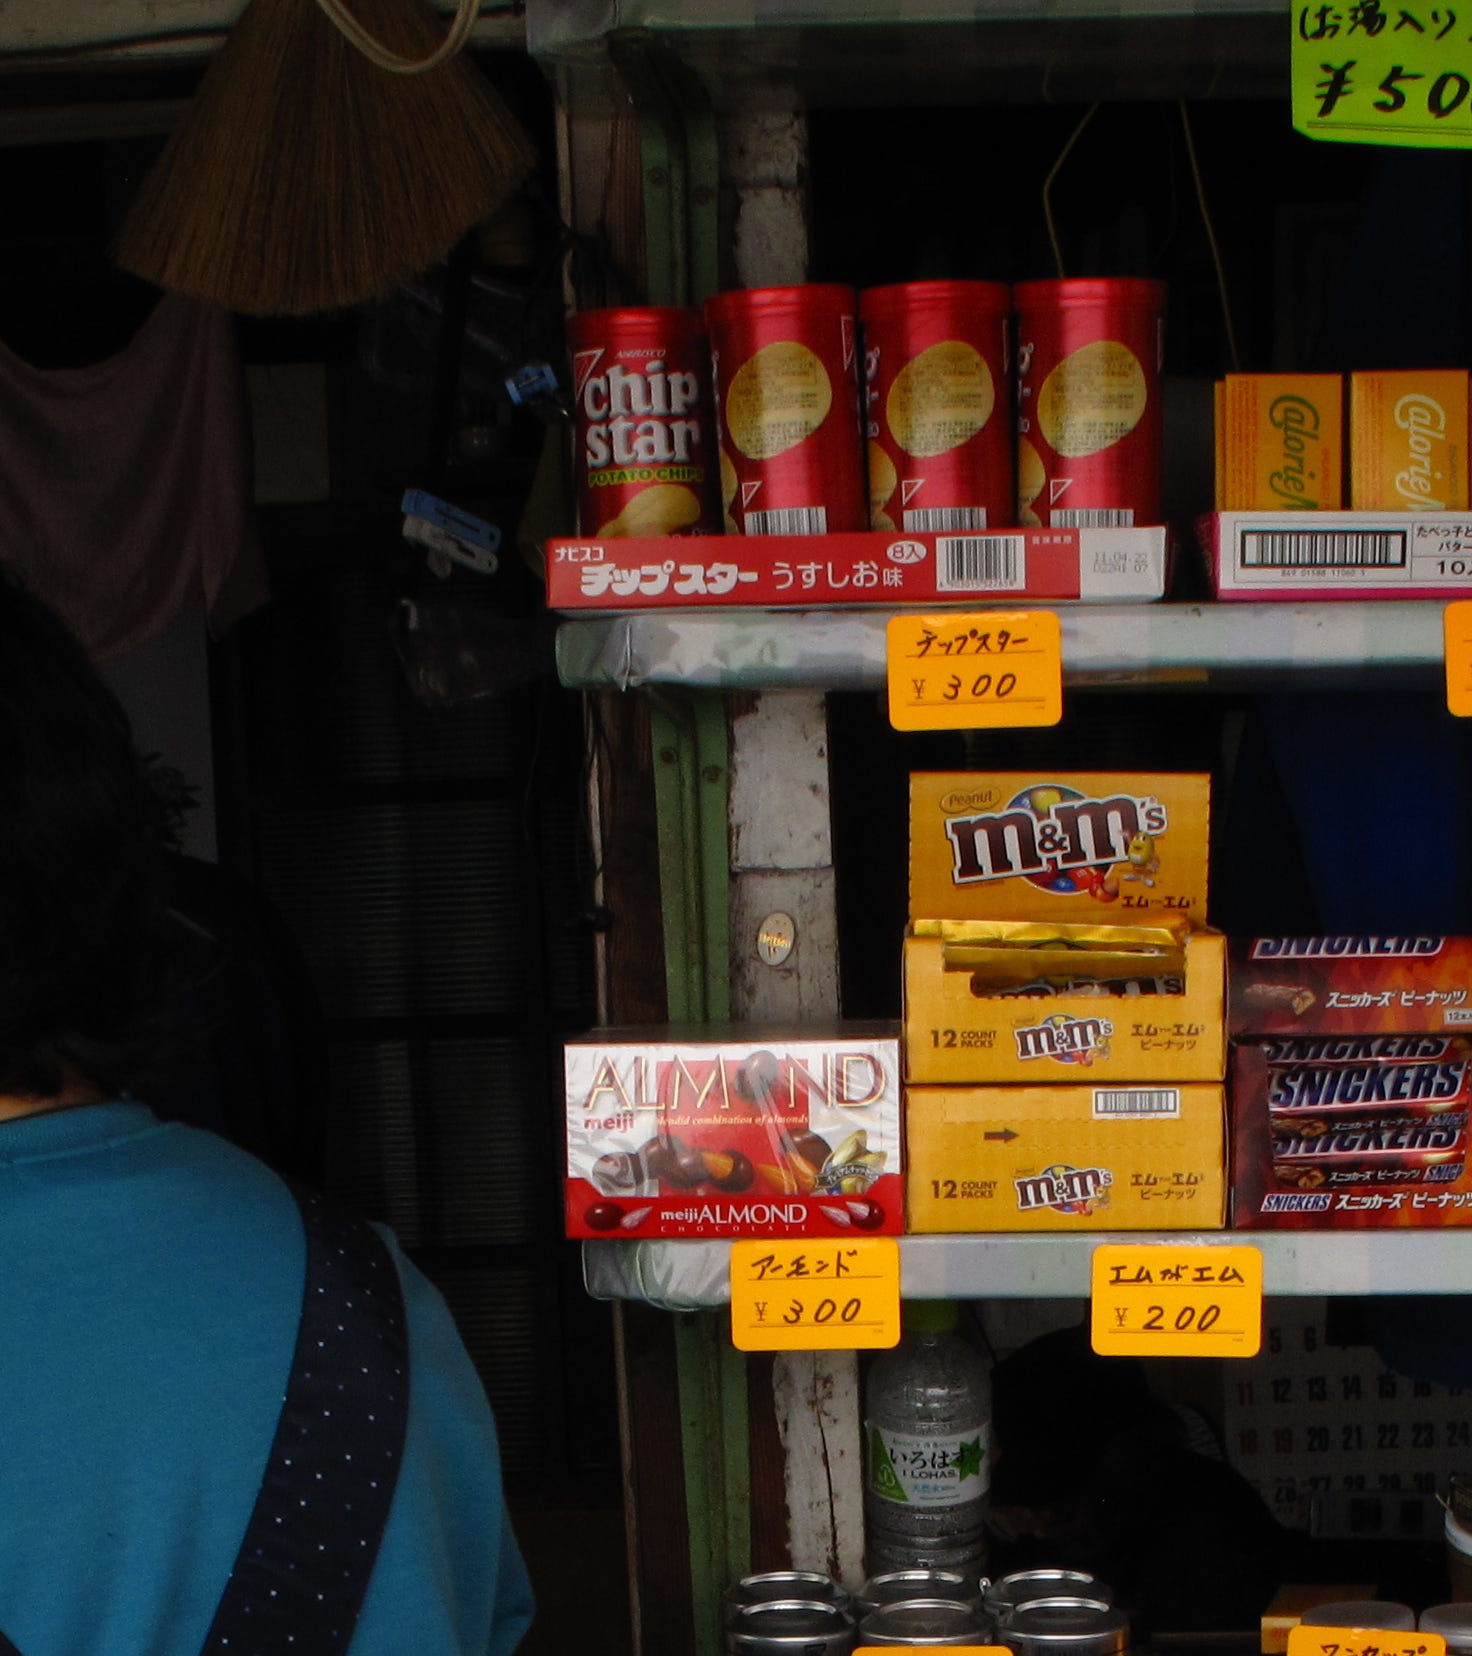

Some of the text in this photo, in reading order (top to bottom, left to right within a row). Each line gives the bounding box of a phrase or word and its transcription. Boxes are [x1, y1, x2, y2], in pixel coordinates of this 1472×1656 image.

[584, 359, 700, 421] chip
[586, 415, 701, 469] star
[588, 466, 705, 488] POTATO CHIPS
[555, 546, 605, 562] ナビスコ
[892, 544, 923, 562] 8入
[580, 560, 904, 597] チップスター うすしお味
[914, 629, 1030, 658] チップスター
[1401, 989, 1468, 1007] ピーナッツ
[931, 1030, 957, 1049] 12
[961, 1030, 997, 1039] COUNT
[961, 1039, 994, 1049] PACKS
[1139, 1039, 1197, 1051] ピーナッツ
[1270, 1061, 1465, 1110] SNICKERS
[582, 1112, 635, 1132] meiji
[691, 1113, 752, 1126] combination
[1260, 1193, 1332, 1212] SNICKERS
[660, 1203, 808, 1225] meiji ALMOND
[749, 1249, 861, 1280] アーモンド
[1240, 1423, 1470, 1454] 18 19 20 21 22 23 24
